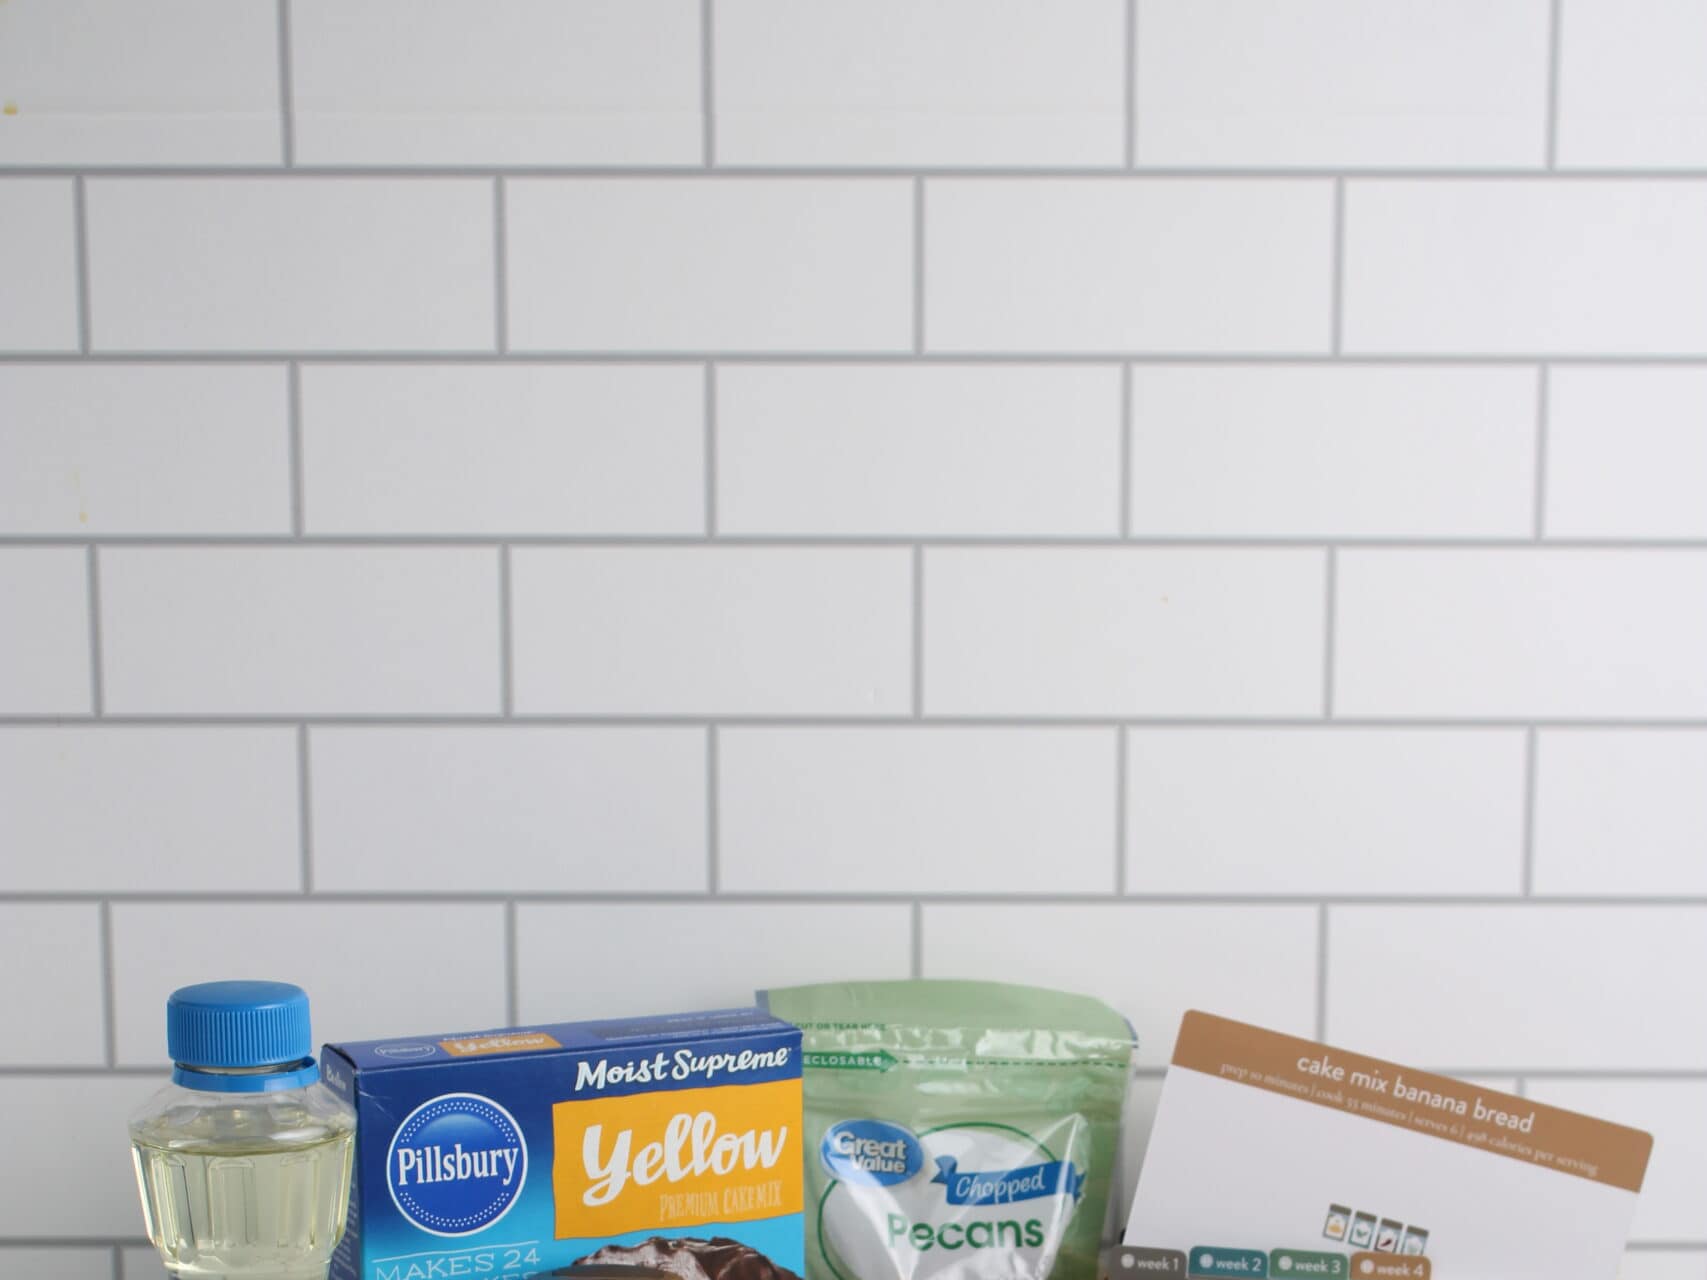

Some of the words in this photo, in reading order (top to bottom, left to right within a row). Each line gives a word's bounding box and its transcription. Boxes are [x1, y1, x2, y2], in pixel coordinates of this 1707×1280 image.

[575, 1052, 670, 1091] Moist
[671, 1048, 790, 1082] Supreme
[803, 1056, 882, 1066] ECLOSABLE
[1297, 1056, 1344, 1081] cake
[1350, 1069, 1389, 1093] mix
[1393, 1076, 1468, 1115] banana
[1473, 1098, 1535, 1133] bread
[834, 1132, 907, 1160] Great
[1361, 1099, 1406, 1121] minutes
[1489, 1135, 1533, 1156] calories
[1534, 1149, 1555, 1162] per
[1556, 1155, 1600, 1177] serving
[397, 1136, 519, 1186] Pillsbury
[582, 1111, 787, 1206] Yellow
[851, 1154, 906, 1173] Value
[956, 1167, 1045, 1202] Chopped
[659, 1192, 719, 1222] PREMIUM
[887, 1214, 1044, 1251] Pecans
[503, 1248, 541, 1270] 24
[1137, 1258, 1170, 1271] week
[1173, 1258, 1179, 1271] 1
[1216, 1257, 1248, 1271] week
[1250, 1259, 1262, 1272] 2
[1295, 1260, 1327, 1273] week
[1331, 1260, 1341, 1273] 3
[1377, 1262, 1410, 1276] week
[1412, 1264, 1424, 1276] 4
